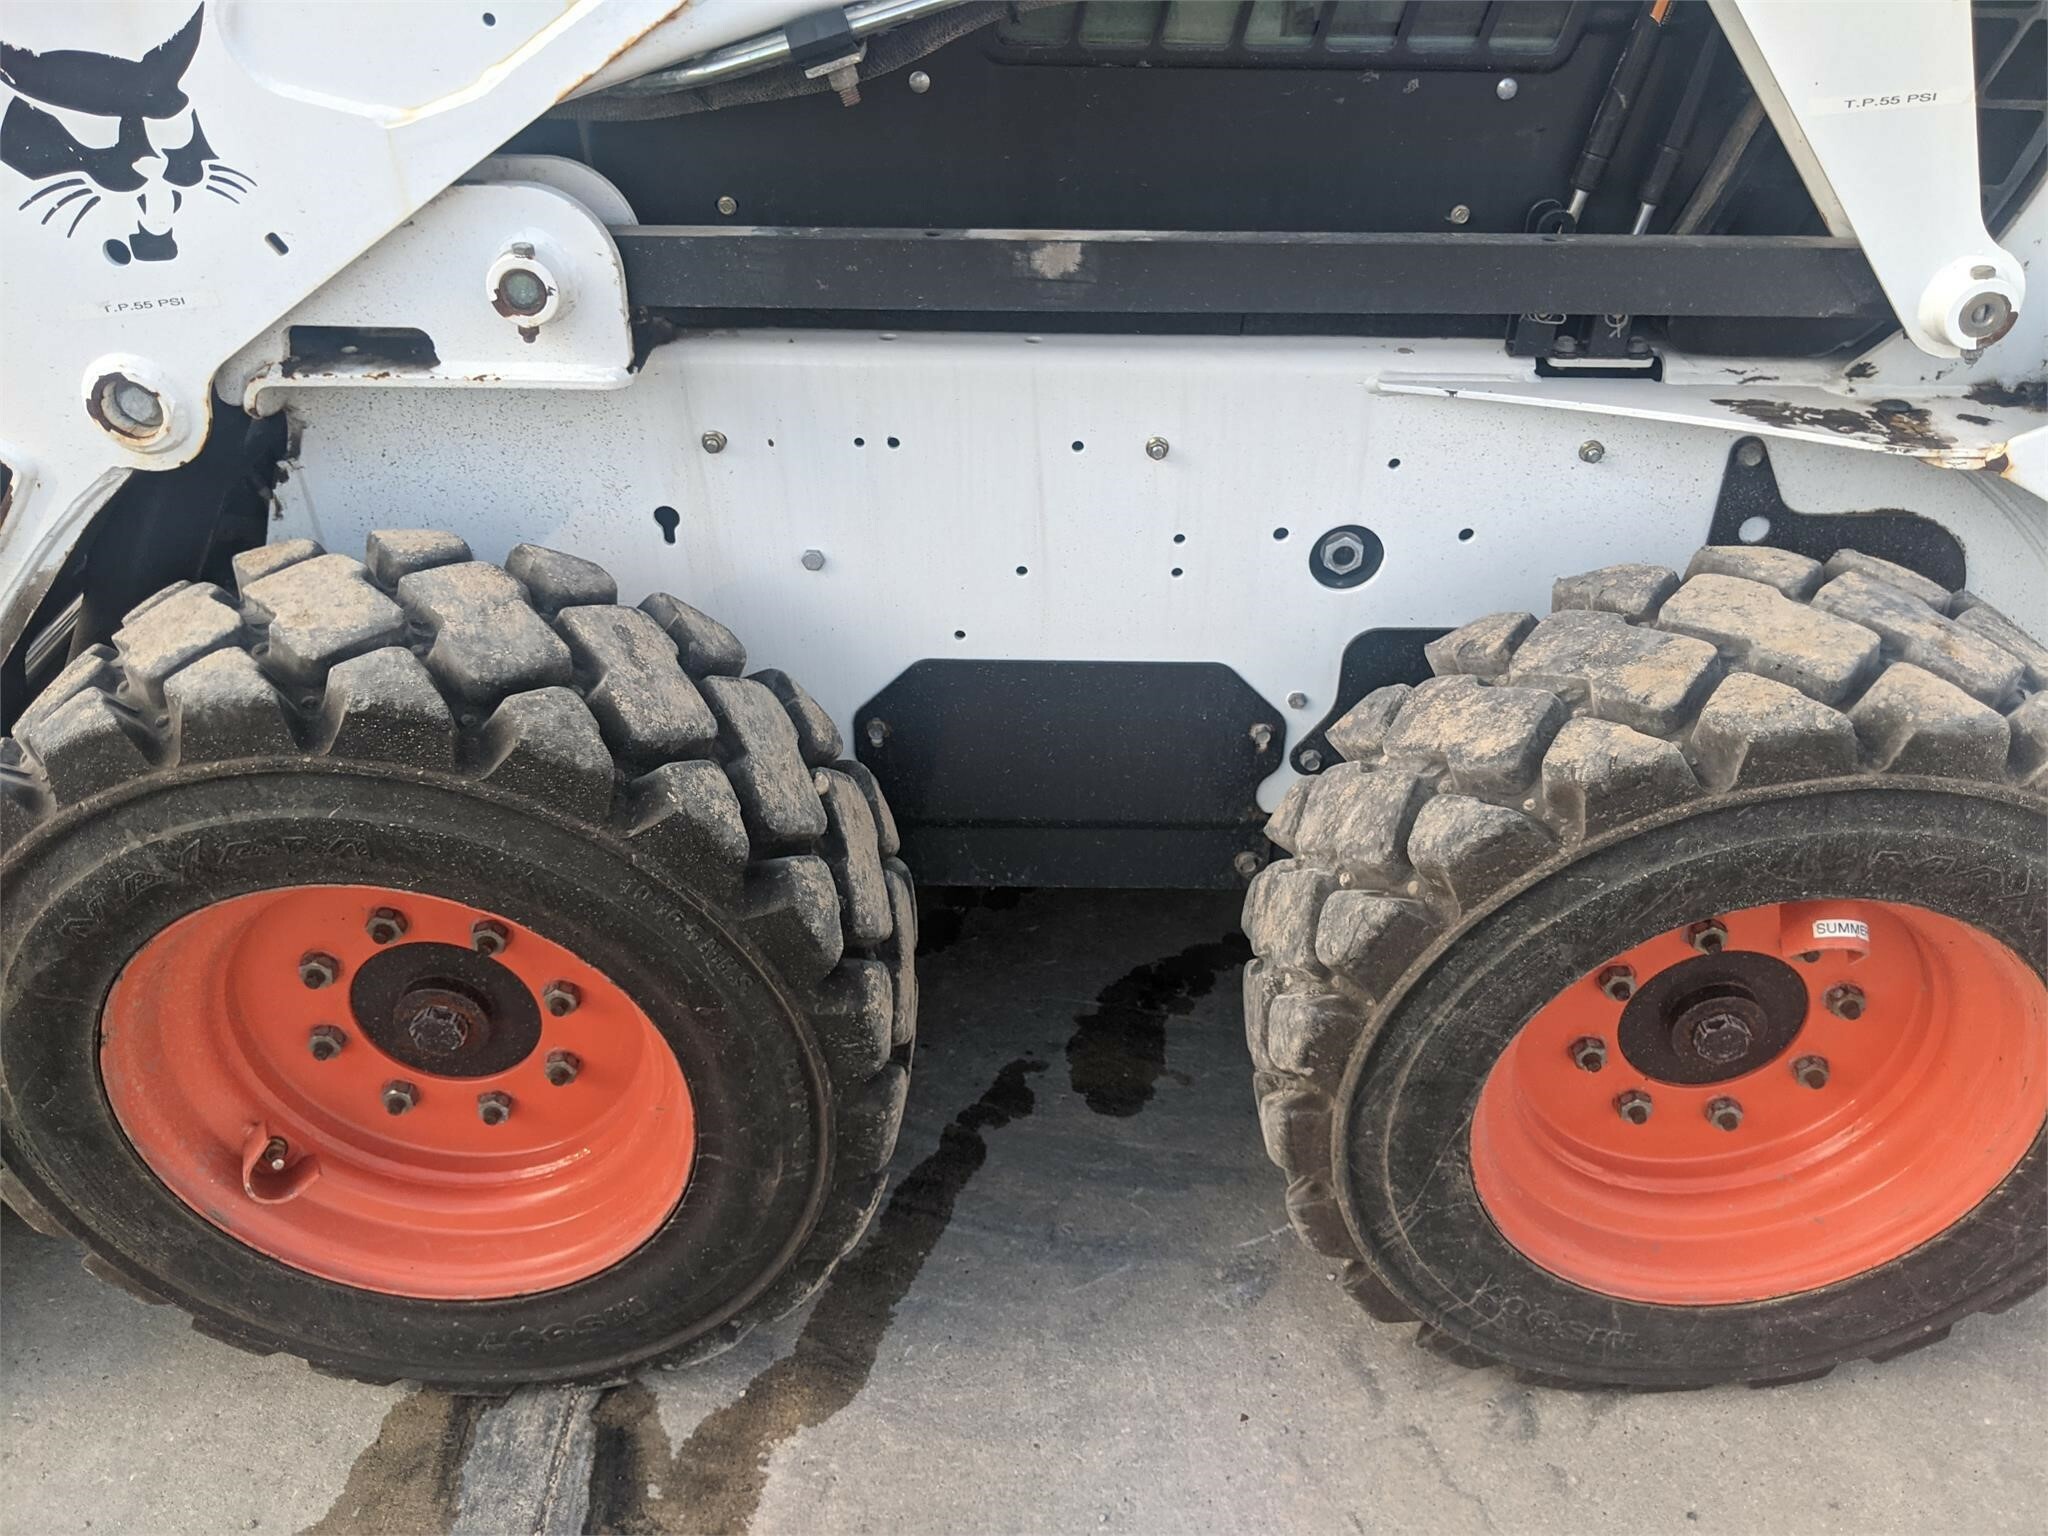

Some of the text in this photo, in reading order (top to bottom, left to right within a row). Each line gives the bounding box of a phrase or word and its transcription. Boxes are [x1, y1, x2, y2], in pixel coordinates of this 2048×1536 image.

[1843, 92, 1938, 109] T.P.55 PSI
[157, 296, 186, 308] PSI
